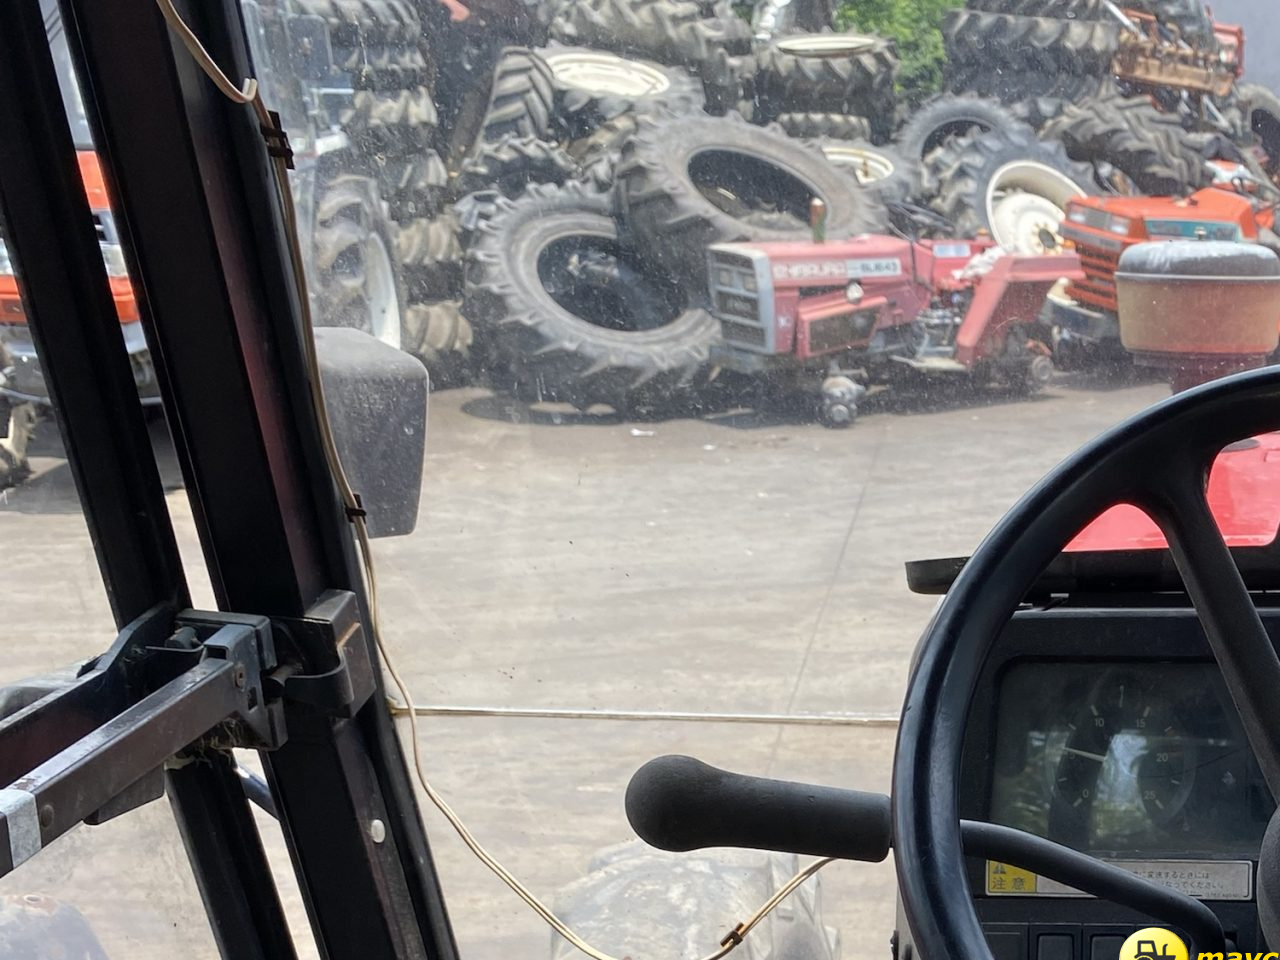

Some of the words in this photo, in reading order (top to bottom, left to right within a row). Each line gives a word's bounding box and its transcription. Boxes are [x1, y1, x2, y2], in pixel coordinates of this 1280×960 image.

[1094, 718, 1105, 727] 10
[1136, 719, 1146, 728] 15
[1156, 752, 1169, 762] 20
[1082, 788, 1089, 798] 0
[1143, 790, 1156, 800] 25
[992, 876, 1026, 891] 注意
